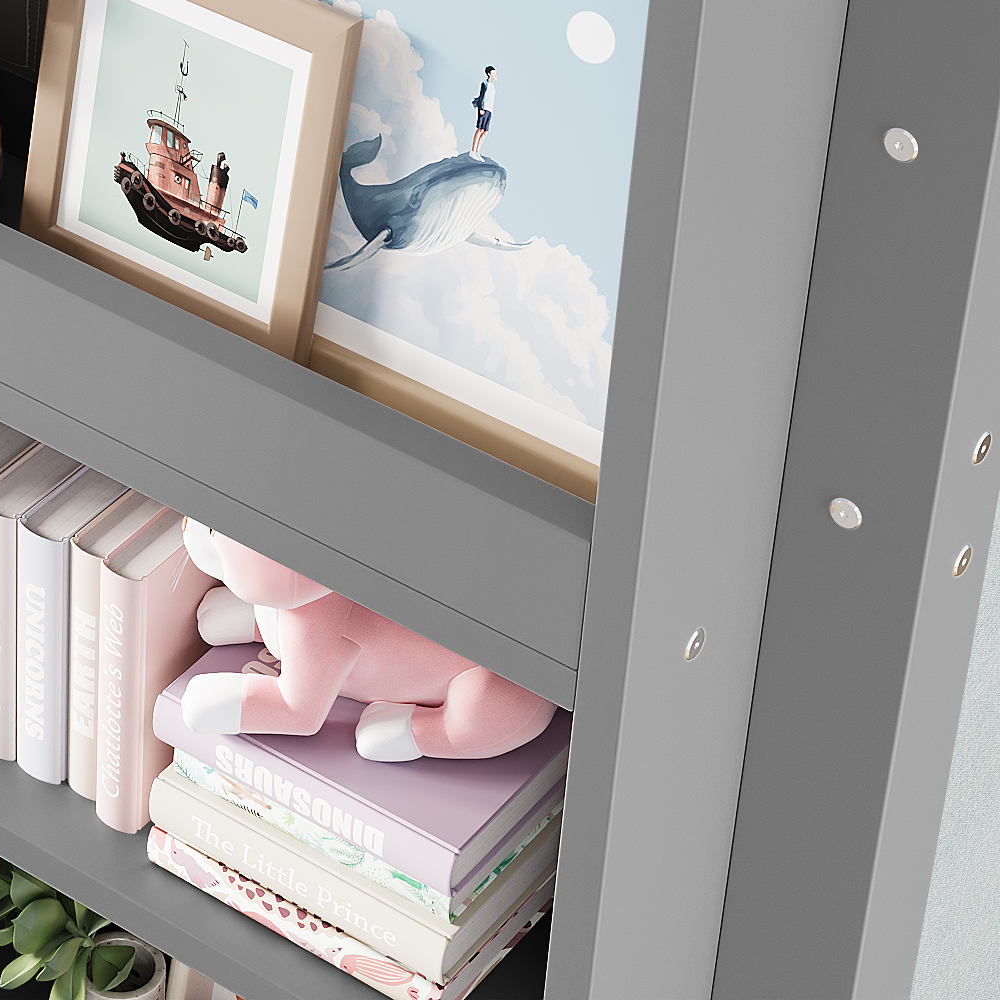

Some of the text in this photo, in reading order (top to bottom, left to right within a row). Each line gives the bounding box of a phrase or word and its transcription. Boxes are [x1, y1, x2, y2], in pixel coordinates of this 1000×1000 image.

[24, 582, 45, 741] UNICORNS
[72, 605, 96, 739] EARTH
[103, 602, 124, 659] Web
[214, 743, 385, 859] DINOSAURS
[191, 814, 397, 948] The Little Prince
